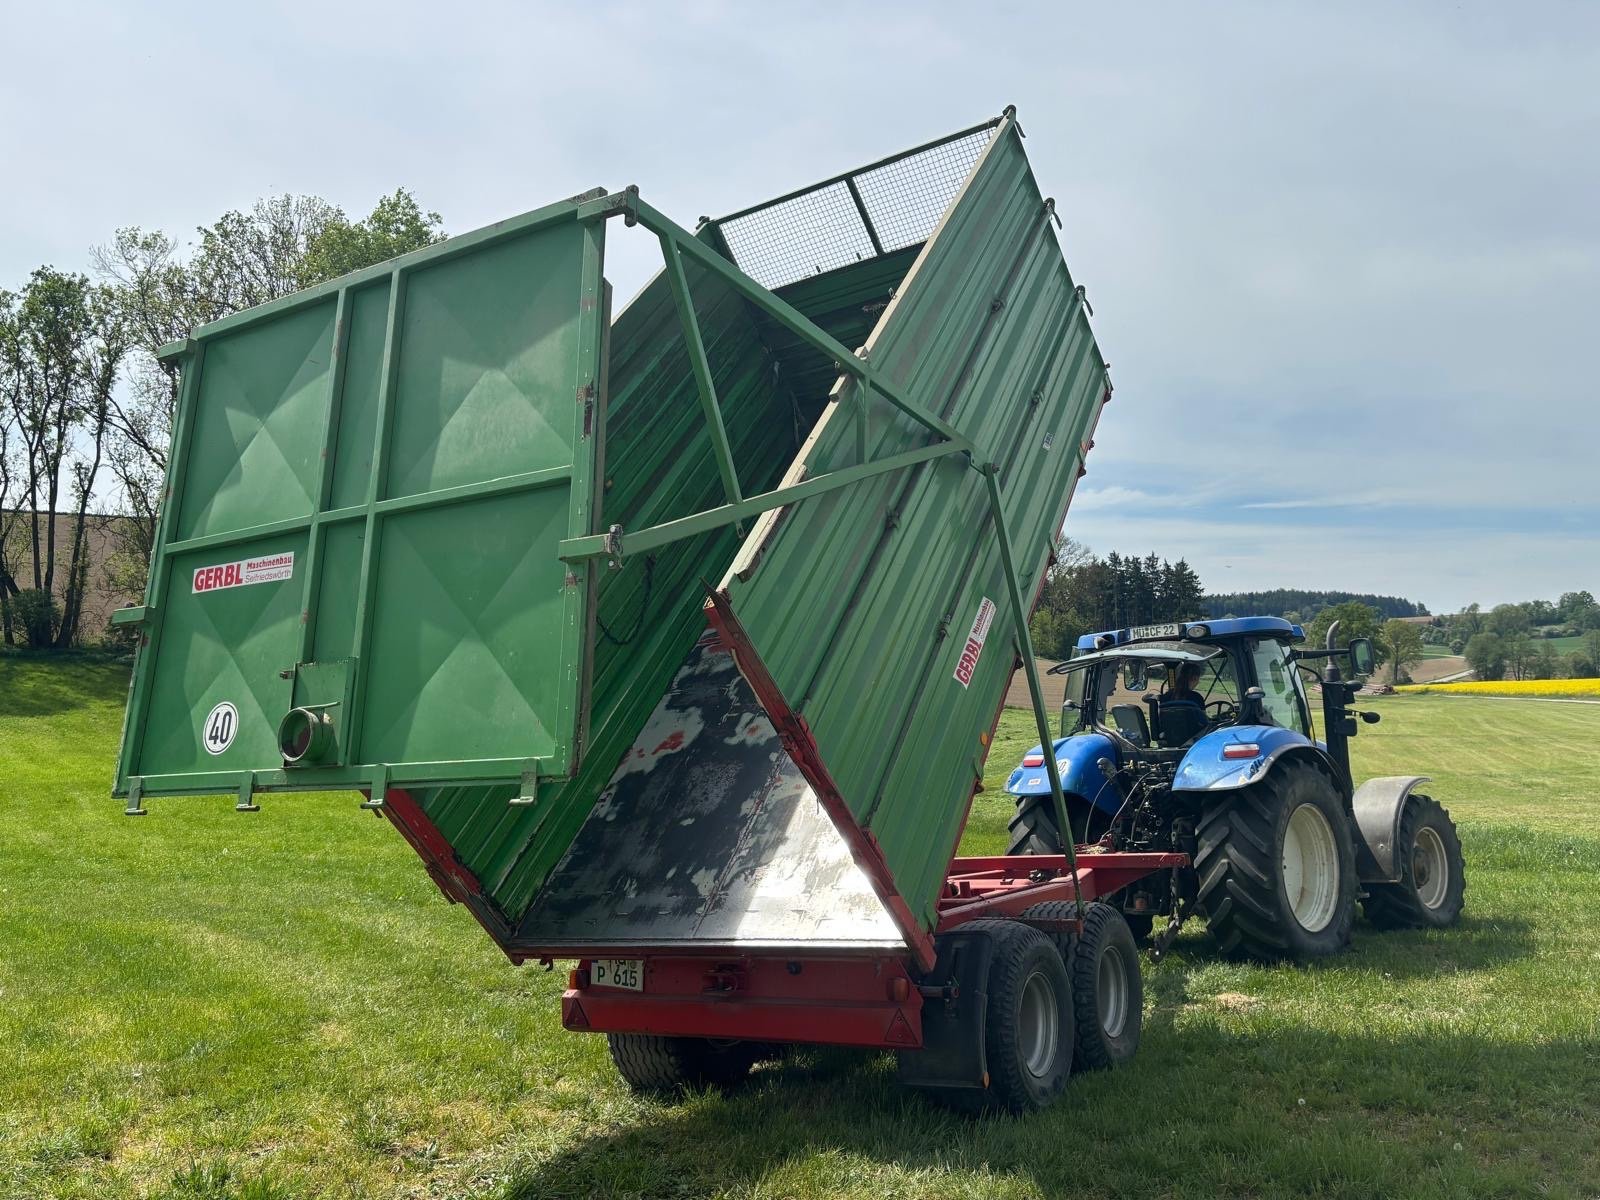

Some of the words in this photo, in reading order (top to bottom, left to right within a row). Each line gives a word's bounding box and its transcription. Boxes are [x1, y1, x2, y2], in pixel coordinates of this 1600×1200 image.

[246, 556, 292, 570] Maschinenbau
[194, 564, 243, 591] GERBL
[1150, 627, 1161, 637] CF
[1163, 625, 1175, 636] 22
[956, 637, 982, 685] GERBL
[209, 711, 232, 744] 40
[597, 966, 605, 983] P
[613, 965, 637, 987] 615
